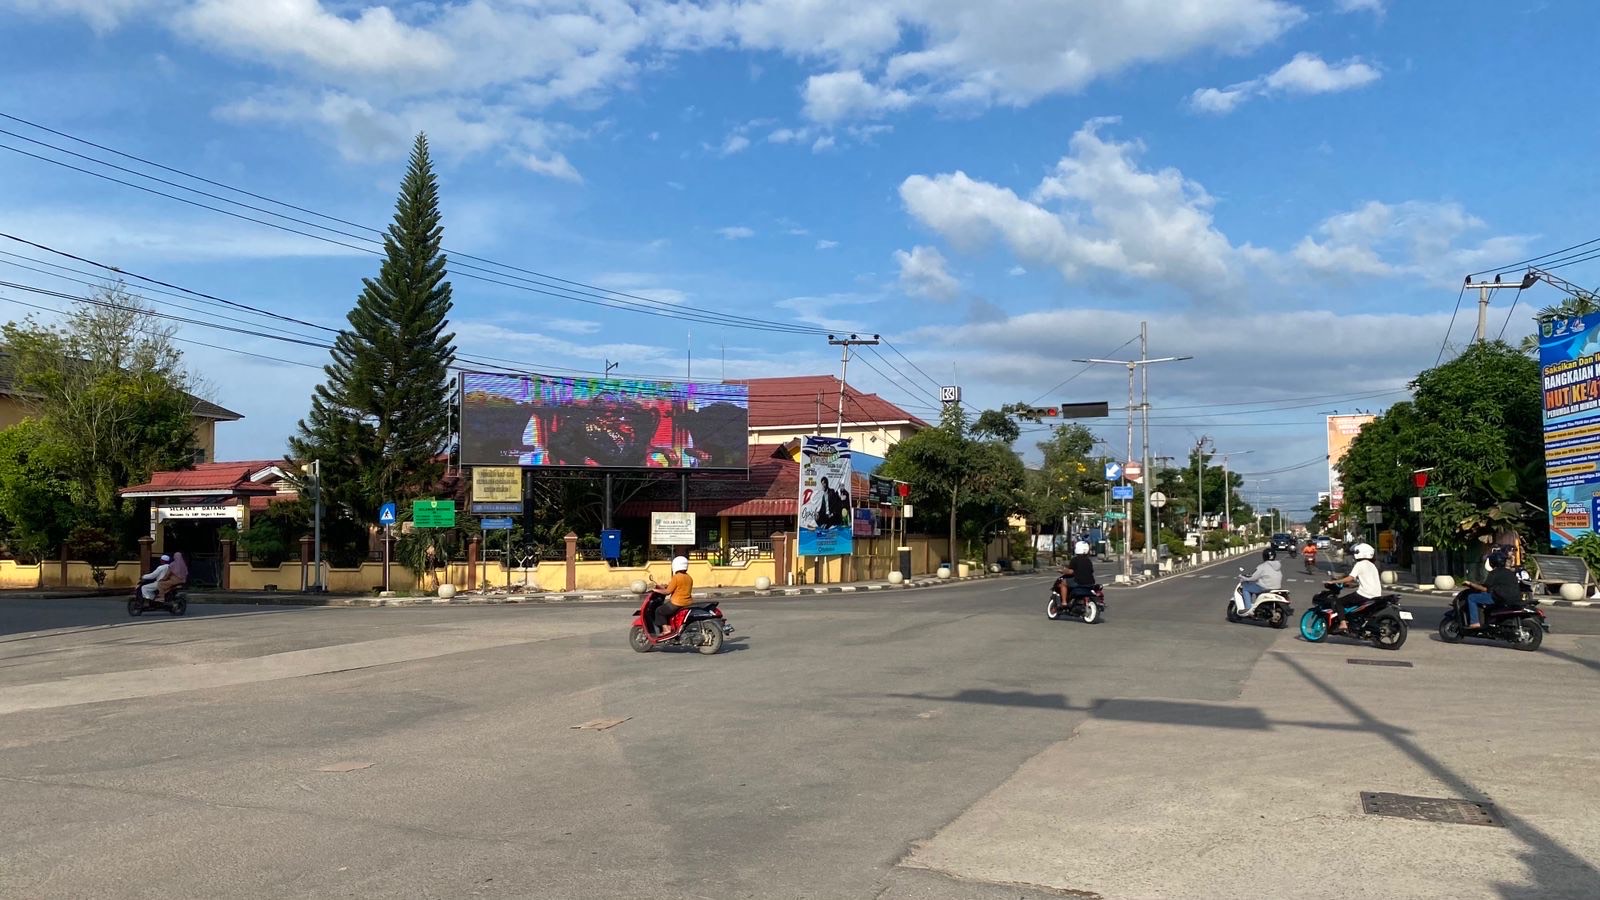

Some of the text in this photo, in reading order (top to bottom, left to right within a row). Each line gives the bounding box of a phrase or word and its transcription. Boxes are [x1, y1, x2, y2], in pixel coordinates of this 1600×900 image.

[1544, 361, 1578, 376] Saksikan
[1579, 356, 1594, 367] Dan
[1544, 364, 1594, 390] RANGKAIAN
[1546, 387, 1569, 409] HUT
[1572, 382, 1588, 402] KE
[1547, 400, 1598, 419] PERUMDA AIR MINUM
